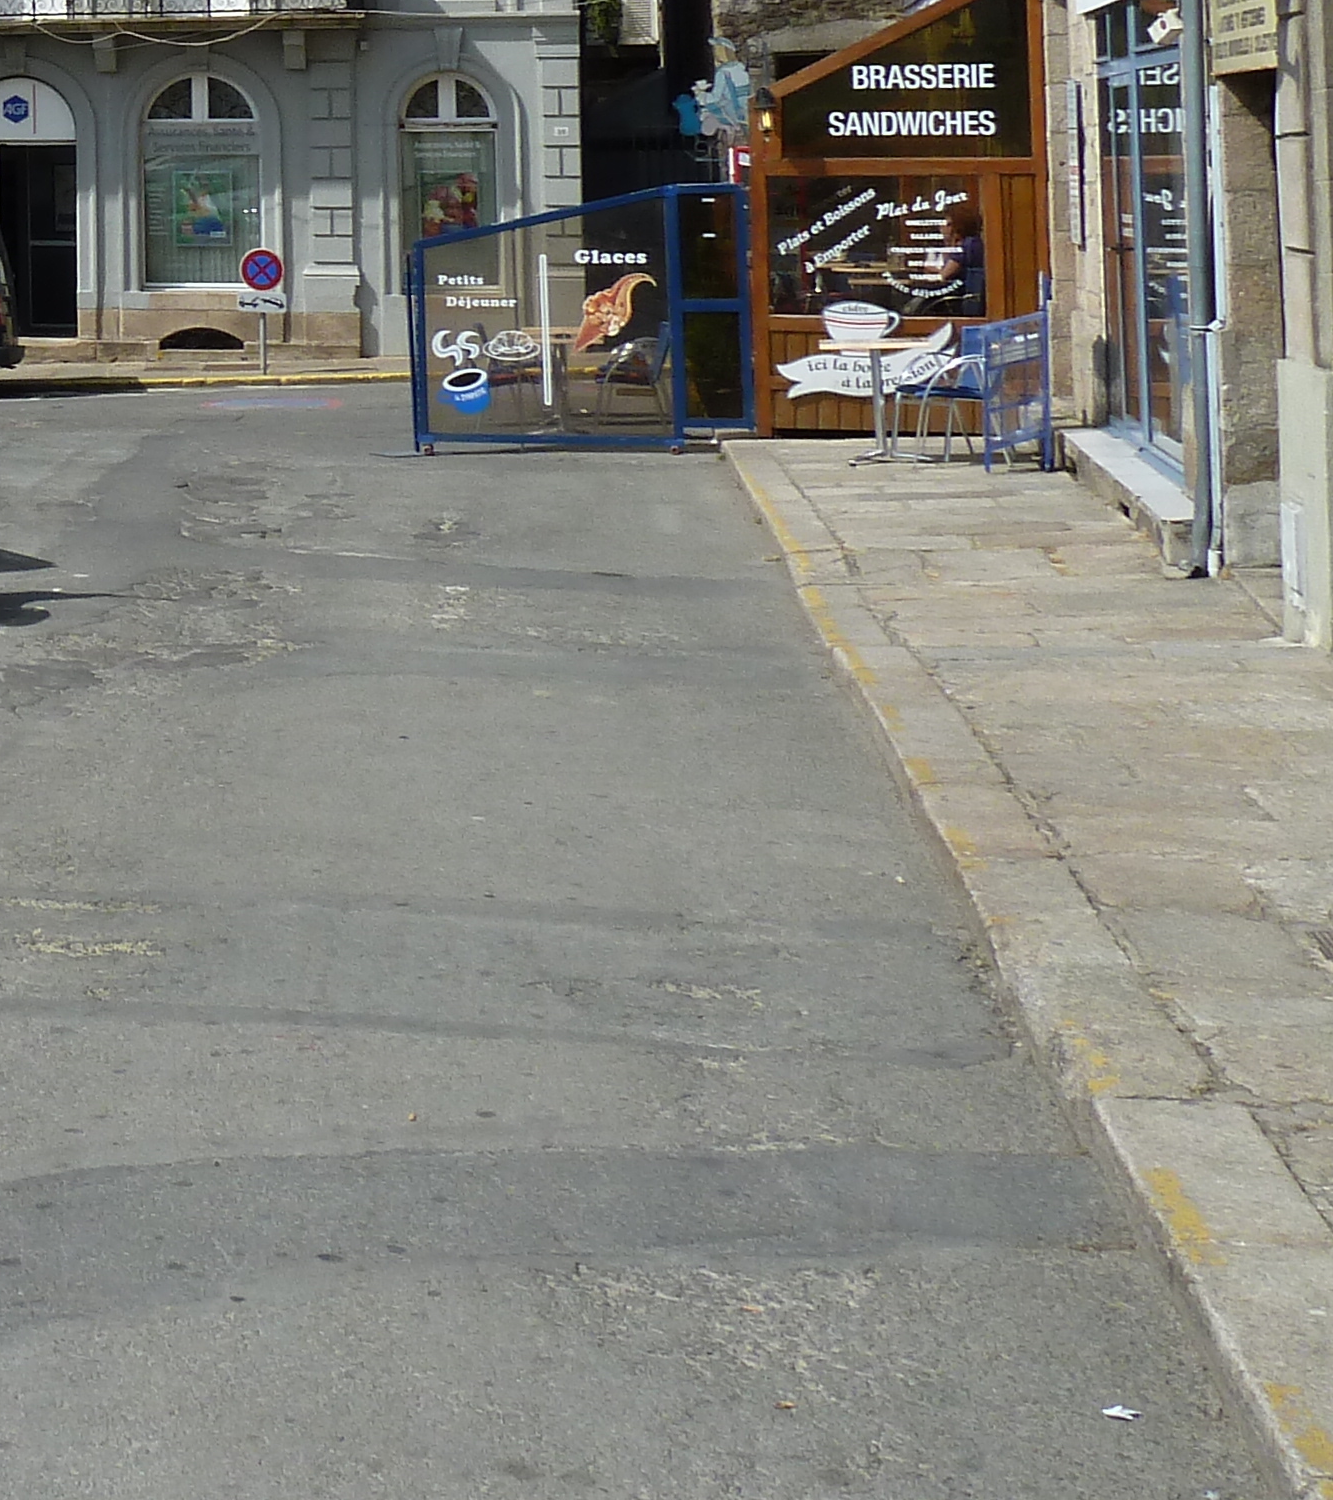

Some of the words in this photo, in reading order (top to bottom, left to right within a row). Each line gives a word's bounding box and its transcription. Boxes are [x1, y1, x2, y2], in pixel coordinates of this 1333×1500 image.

[852, 63, 996, 89] BRASSERIE
[3, 103, 29, 116] AGF
[828, 110, 996, 136] SANDWICHES
[875, 201, 909, 221] Plat
[912, 195, 931, 212] du
[935, 189, 969, 212] Jour
[776, 231, 811, 256] Plats
[811, 220, 826, 236] et
[823, 186, 878, 228] Boissons
[813, 223, 872, 267] Emporter
[574, 250, 648, 265] Glaces
[437, 275, 484, 286] Petits
[445, 296, 518, 309] Déjeuner
[807, 359, 827, 372] ici
[833, 358, 848, 371] la
[856, 377, 873, 389] la
